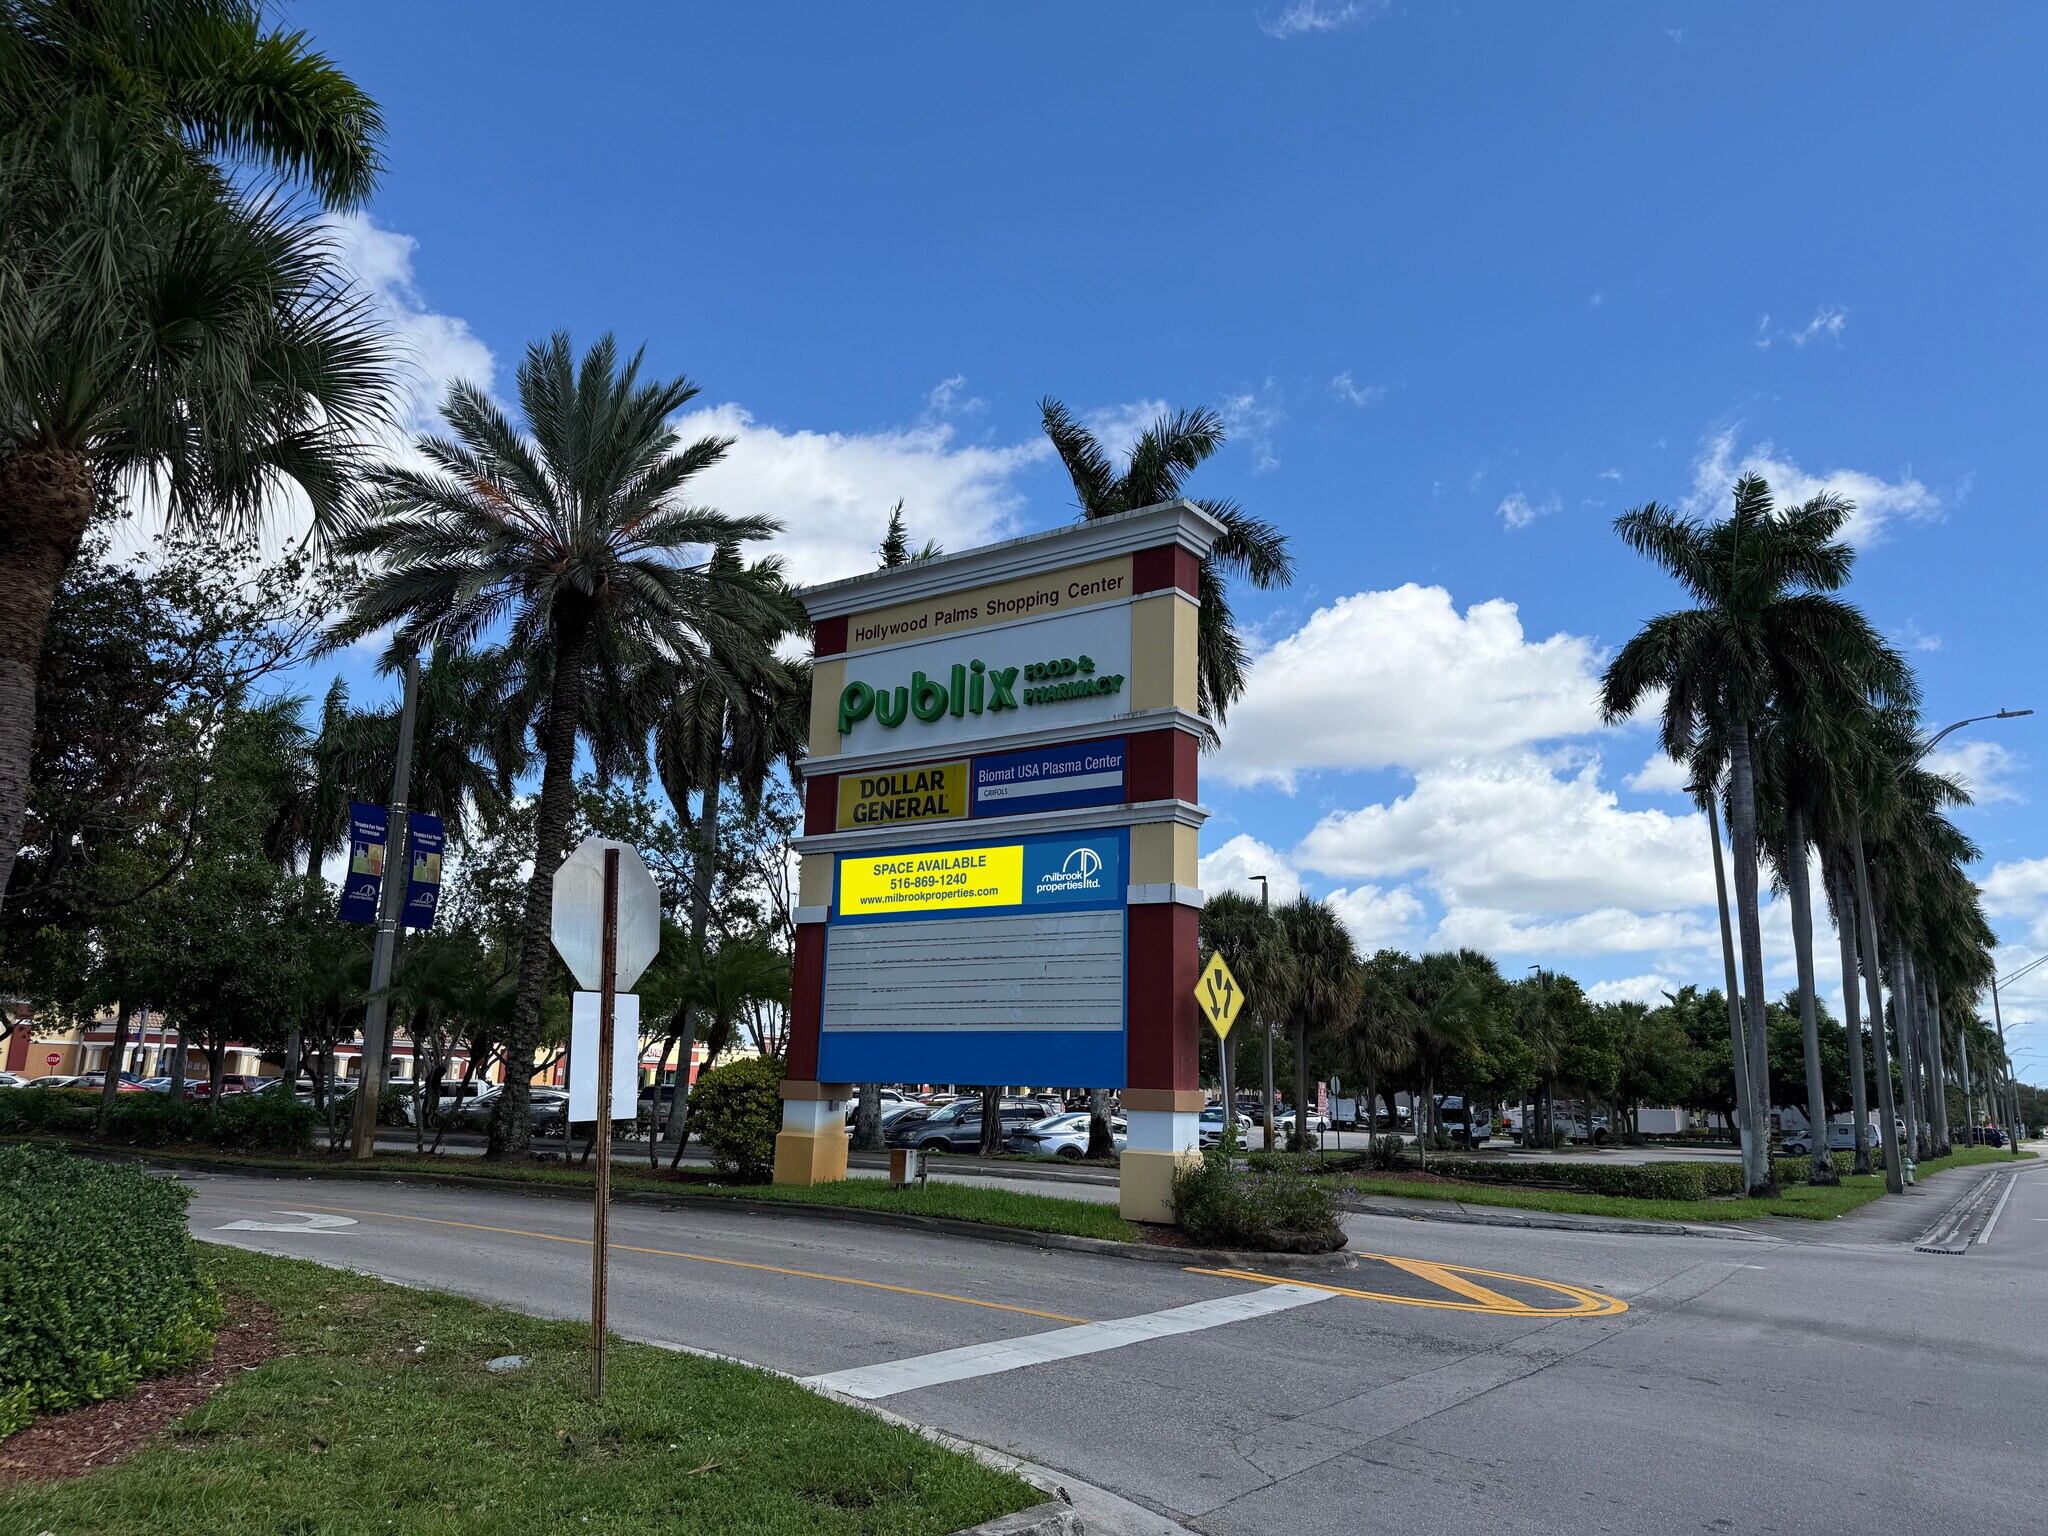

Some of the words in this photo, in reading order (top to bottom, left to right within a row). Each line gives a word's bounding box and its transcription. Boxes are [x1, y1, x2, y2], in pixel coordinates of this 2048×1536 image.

[855, 614, 928, 643] Hollywood
[934, 605, 978, 626] Palms
[986, 588, 1059, 616] Shopping
[1067, 575, 1124, 599] Center
[1024, 658, 1077, 683] FOOD
[1077, 654, 1096, 674] &
[838, 658, 1019, 734] Publix
[1023, 673, 1125, 706] PHARMACY
[978, 768, 1015, 783] Biomat
[1017, 764, 1040, 779] USA
[1042, 758, 1082, 775] Plasma
[1084, 754, 1122, 770] Center
[860, 770, 945, 800] DOLLAR
[983, 787, 1008, 798] GRIFOLS
[853, 794, 950, 823] GENERAL
[354, 821, 369, 829] Thanks
[359, 828, 380, 837] Patronage
[873, 861, 914, 876] SPACE
[916, 855, 987, 872] AVAILABLE
[1041, 869, 1083, 883] milbrook
[889, 873, 967, 890] 516-869-1240
[1036, 881, 1083, 894] properties
[860, 886, 999, 905] www.milbrookproperties.com
